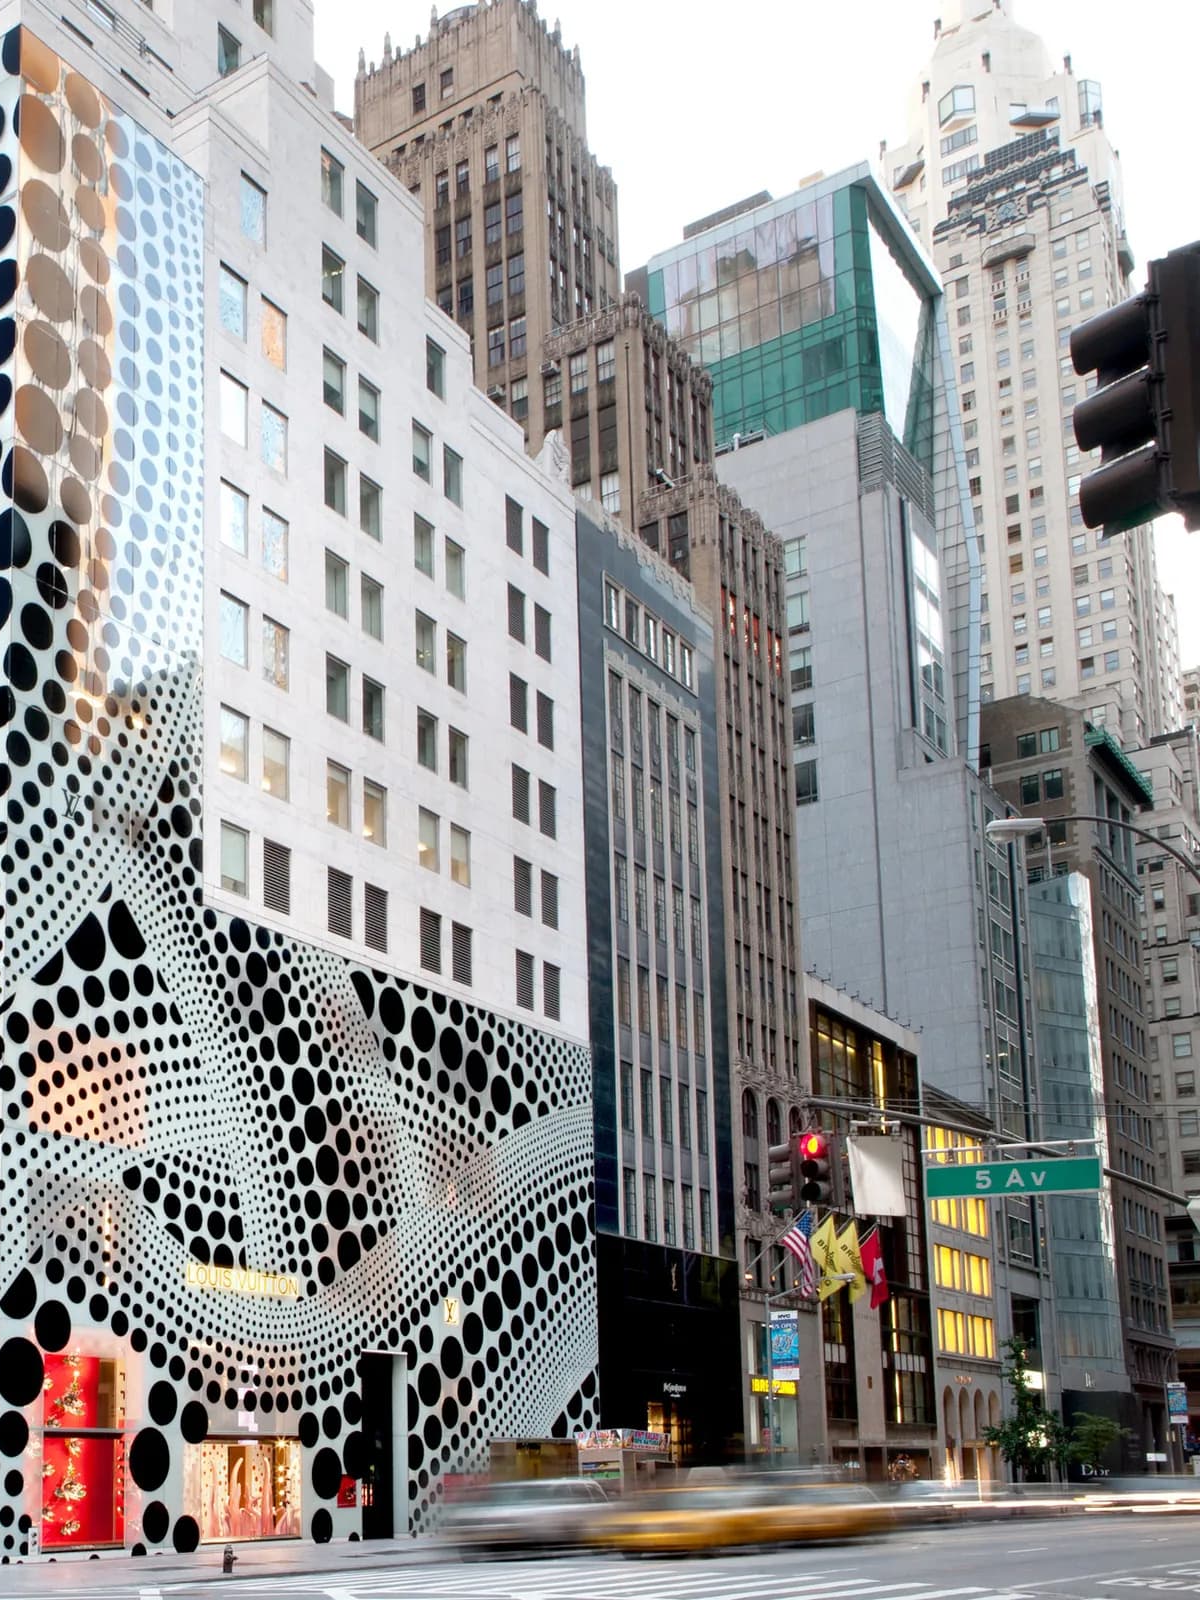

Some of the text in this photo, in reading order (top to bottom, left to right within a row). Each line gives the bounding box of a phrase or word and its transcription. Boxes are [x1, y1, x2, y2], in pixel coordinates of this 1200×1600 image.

[975, 1168, 1047, 1190] 5 Av
[187, 1266, 298, 1295] LOUIS VUITTON
[1081, 1464, 1110, 1476] Dior
